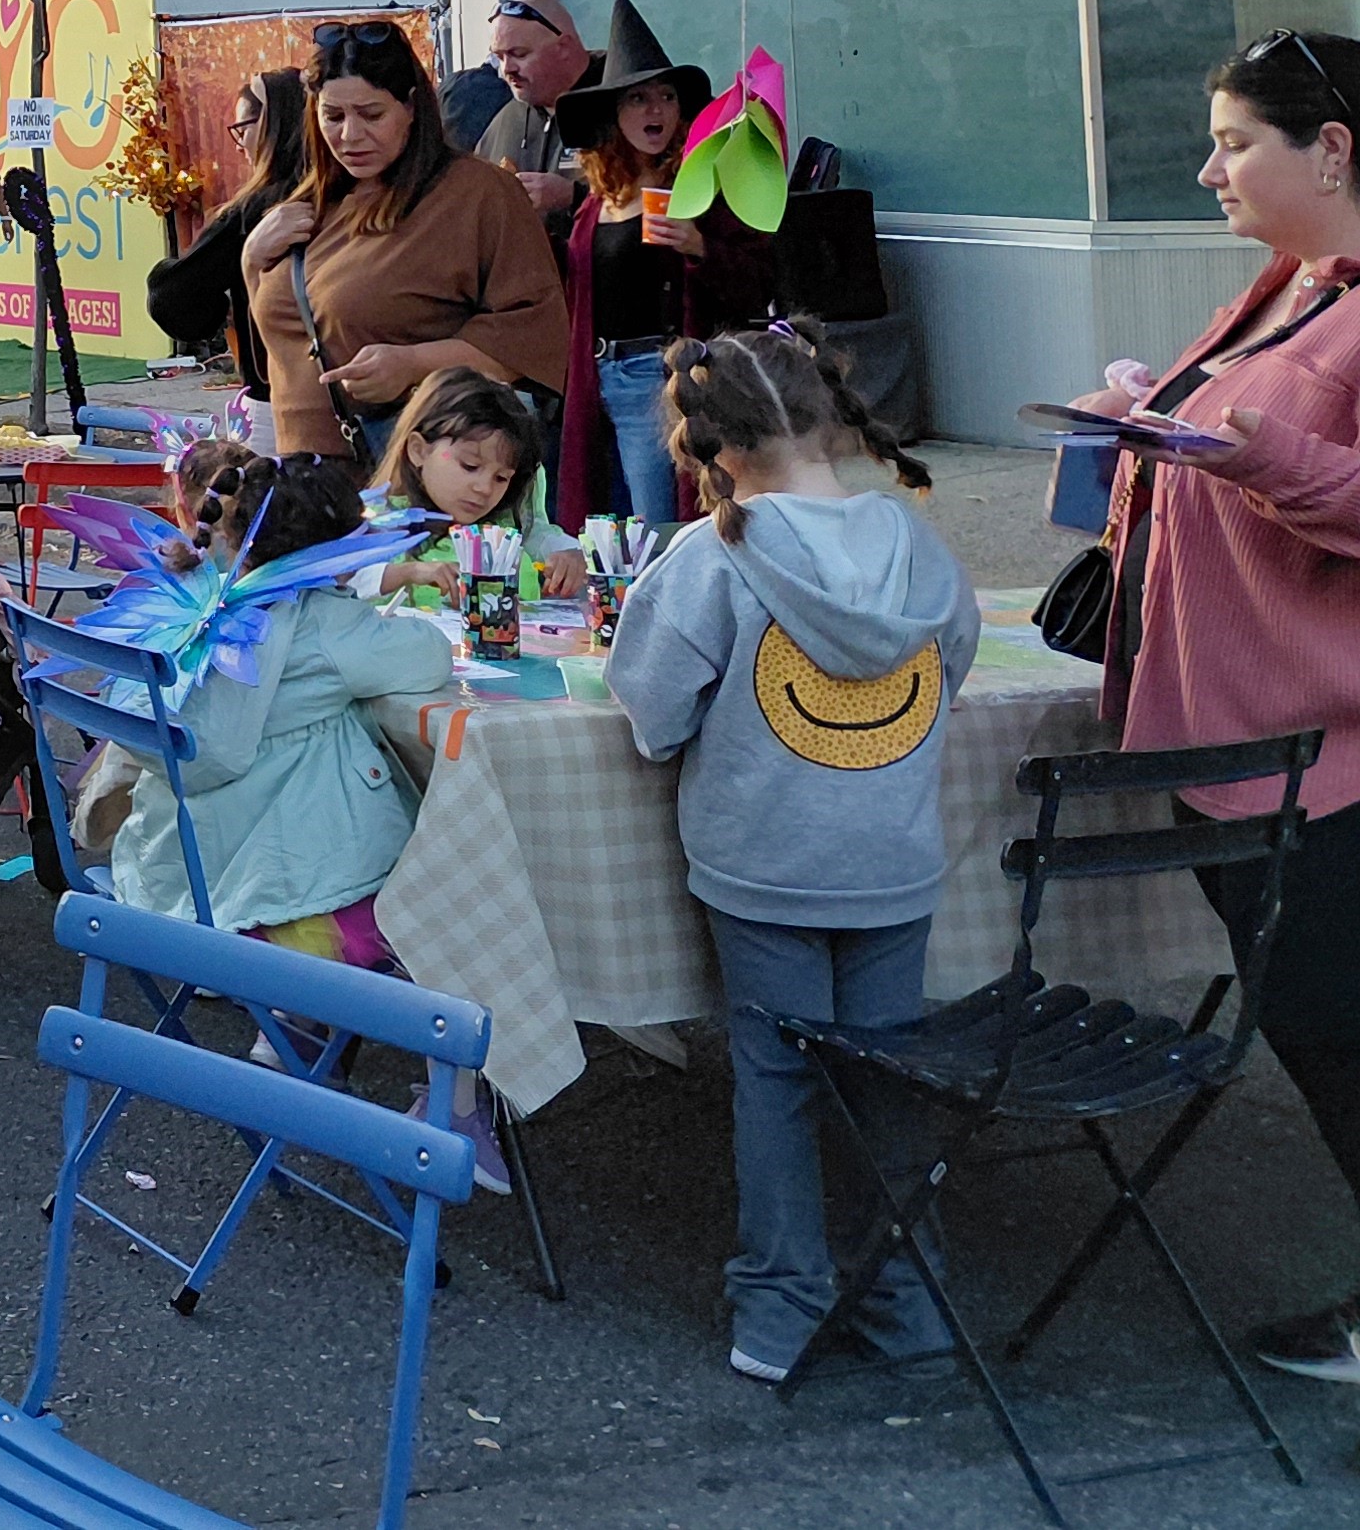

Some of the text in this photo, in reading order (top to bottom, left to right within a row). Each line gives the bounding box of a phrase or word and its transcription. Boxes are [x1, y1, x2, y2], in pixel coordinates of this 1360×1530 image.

[23, 100, 37, 113] NO
[10, 114, 51, 126] PARKING
[10, 130, 51, 141] SATURDAY
[10, 293, 31, 319] OF
[68, 298, 117, 329] AGES!
